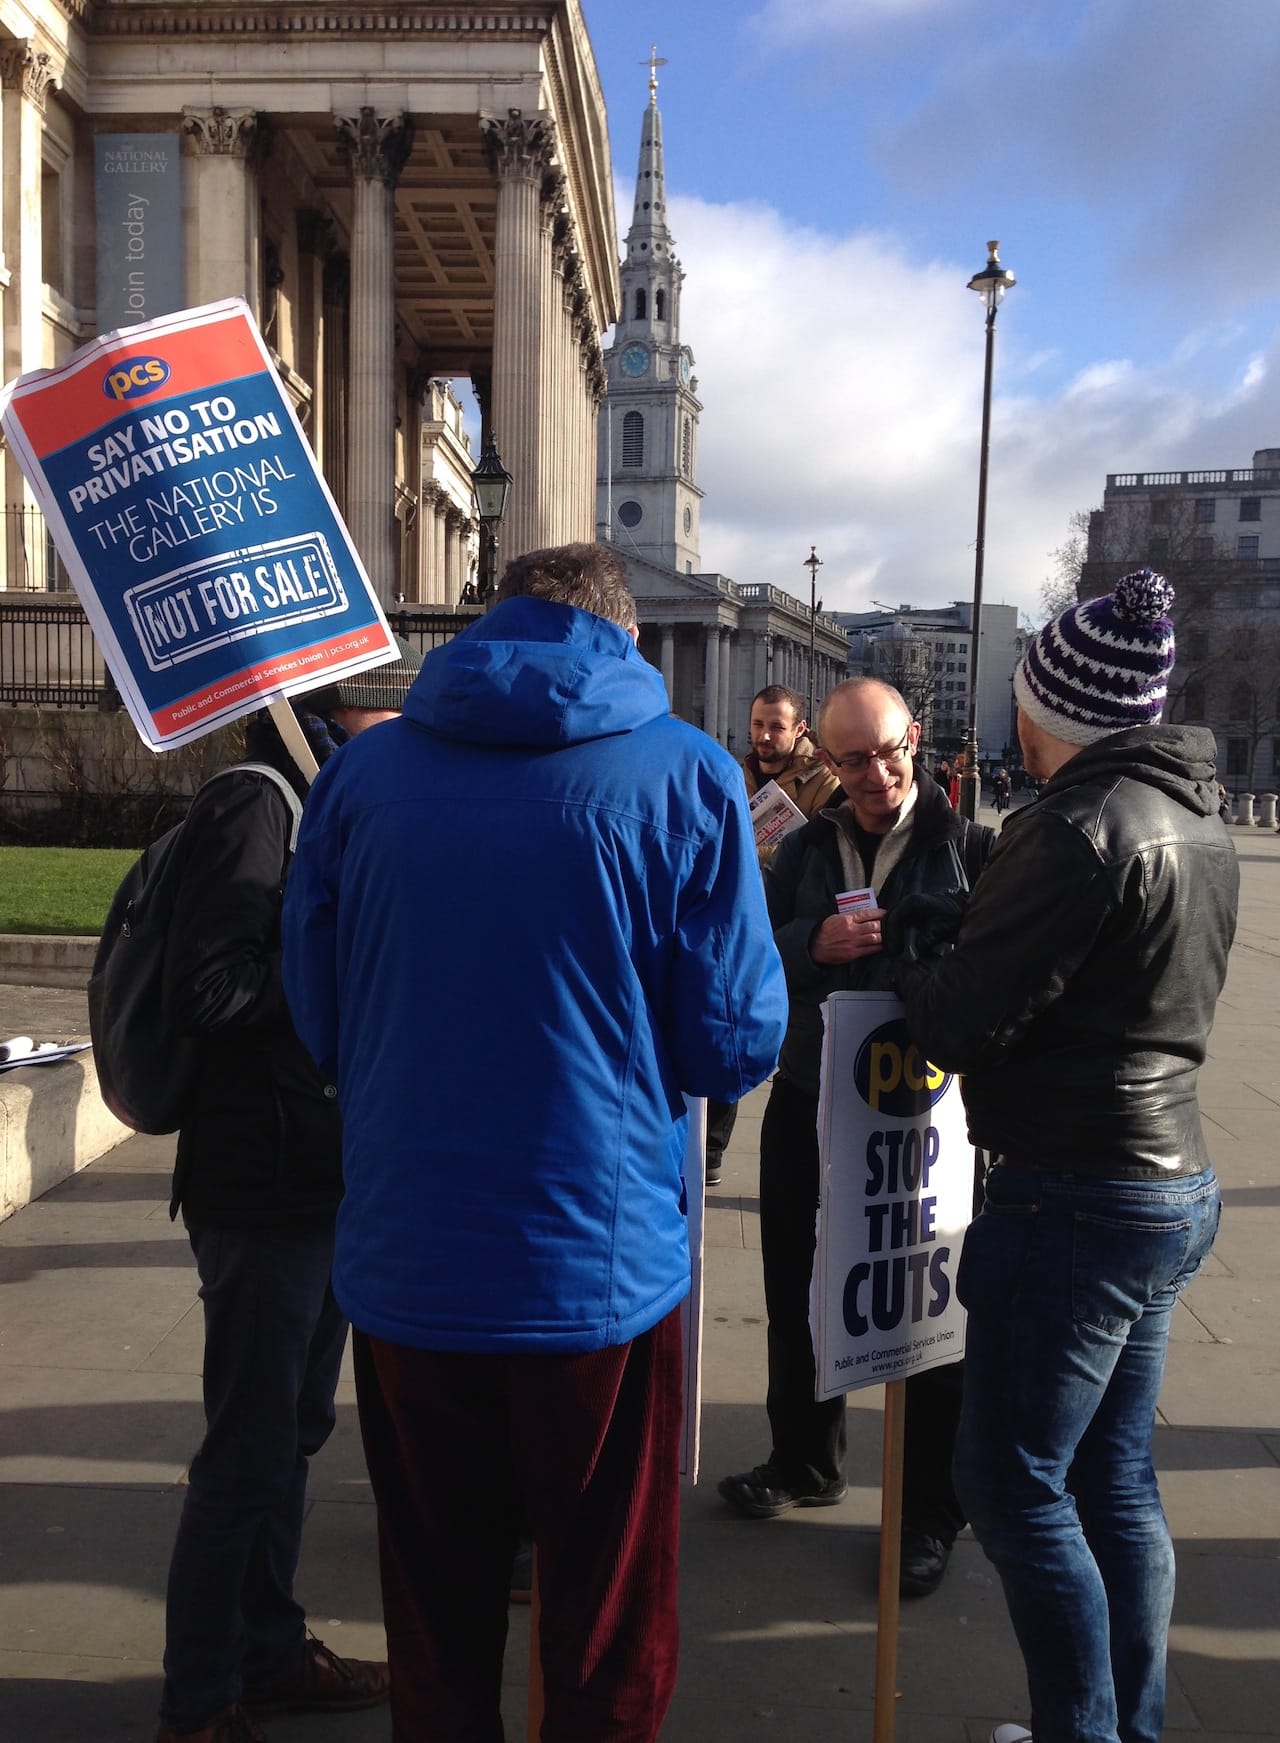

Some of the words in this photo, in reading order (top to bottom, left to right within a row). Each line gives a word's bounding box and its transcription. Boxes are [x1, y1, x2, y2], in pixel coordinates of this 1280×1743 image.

[104, 151, 169, 161] NATIONAL
[104, 161, 169, 174] GALLERY
[122, 193, 150, 262] today
[122, 271, 145, 319] Join
[108, 360, 165, 400] pcs
[68, 411, 282, 514] PRIVATISATION
[87, 425, 136, 472] SAY
[139, 409, 190, 444] NO
[189, 396, 236, 427] TO
[87, 505, 147, 550] THE
[145, 455, 296, 523] NATIONAL
[129, 495, 245, 563] GALLERY
[250, 488, 278, 517] IS
[143, 588, 200, 648] NOT
[198, 571, 260, 626] FOR
[255, 554, 329, 609] SALE
[172, 704, 197, 720] Public
[198, 695, 213, 708] and
[213, 672, 263, 700] Commercial
[263, 661, 298, 678] Services
[298, 651, 323, 666] Union
[330, 635, 369, 656] pcs.org.uk
[865, 1126, 940, 1197] STOP
[864, 1196, 938, 1253] THE
[842, 1246, 951, 1337] CUTS
[834, 1359, 854, 1372] Public
[855, 1351, 870, 1365] and
[871, 1341, 912, 1361] Commercial
[912, 1336, 935, 1350] Services
[936, 1330, 955, 1343] Union
[871, 1351, 922, 1373] www.pcs.org.uk
